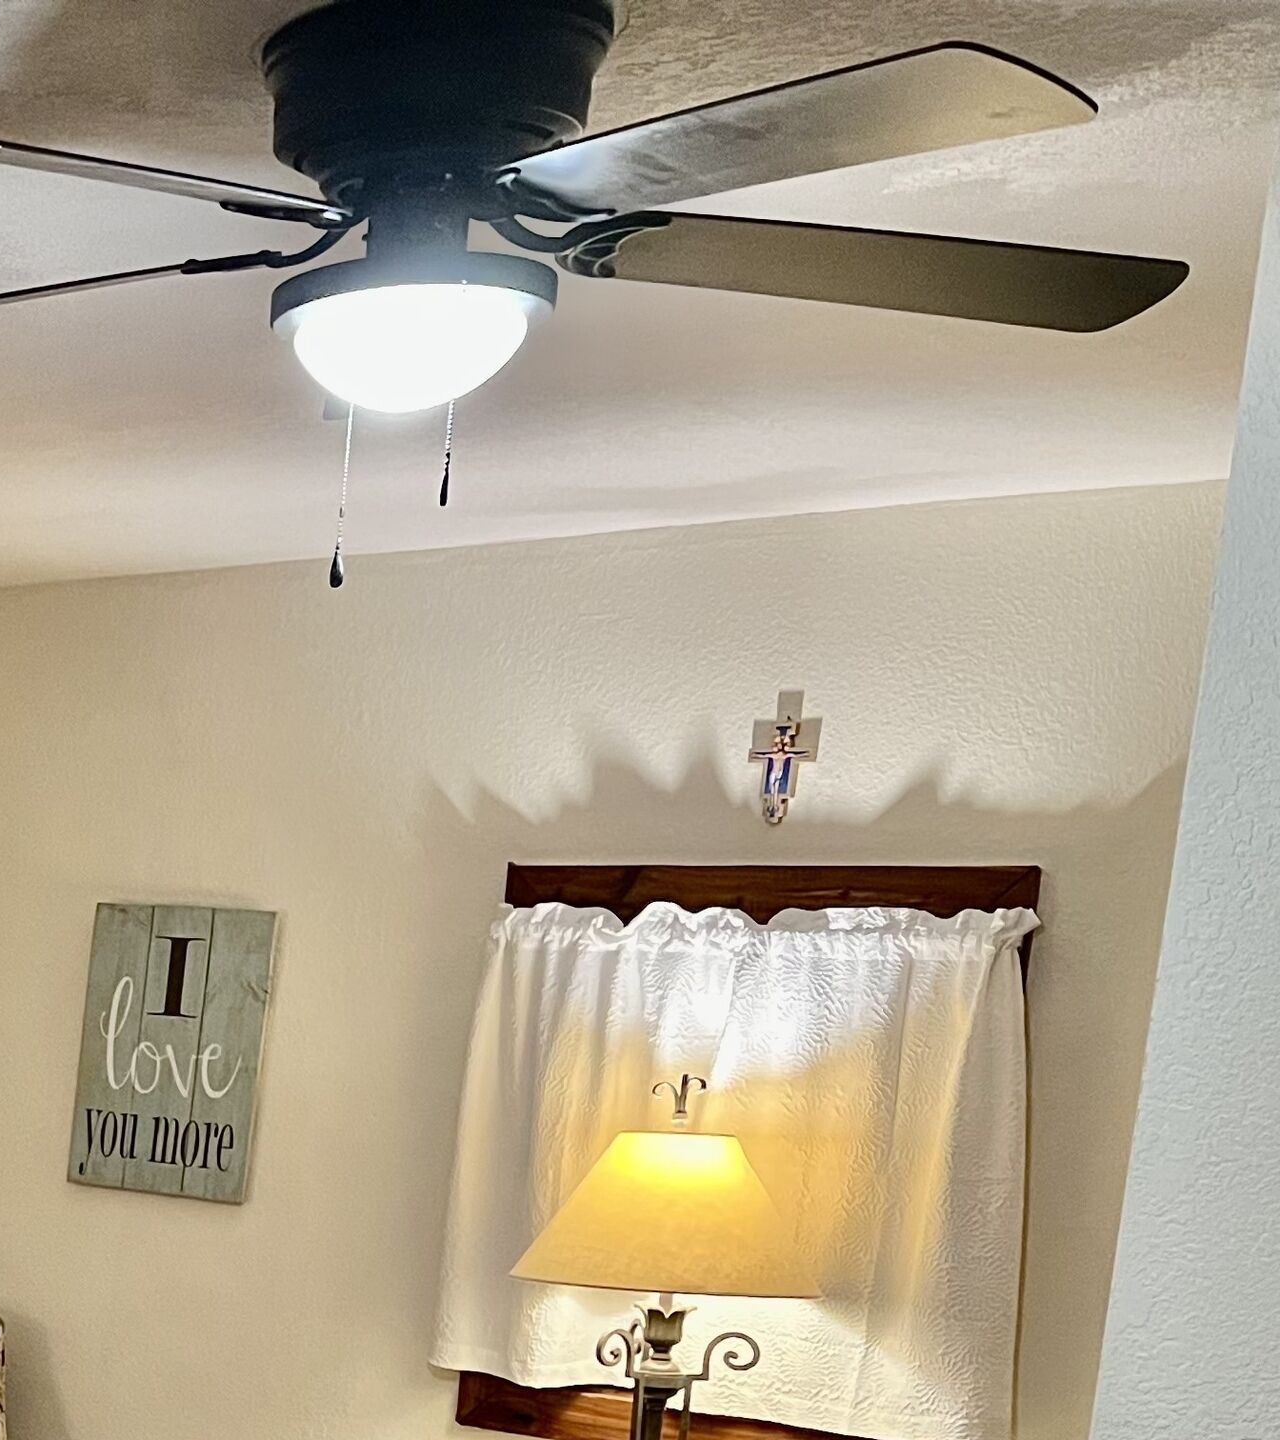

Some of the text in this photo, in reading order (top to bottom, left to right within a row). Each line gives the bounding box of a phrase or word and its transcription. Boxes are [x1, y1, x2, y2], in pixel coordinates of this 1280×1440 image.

[147, 935, 207, 1019] I
[100, 976, 242, 1099] love
[78, 1108, 235, 1175] you more
